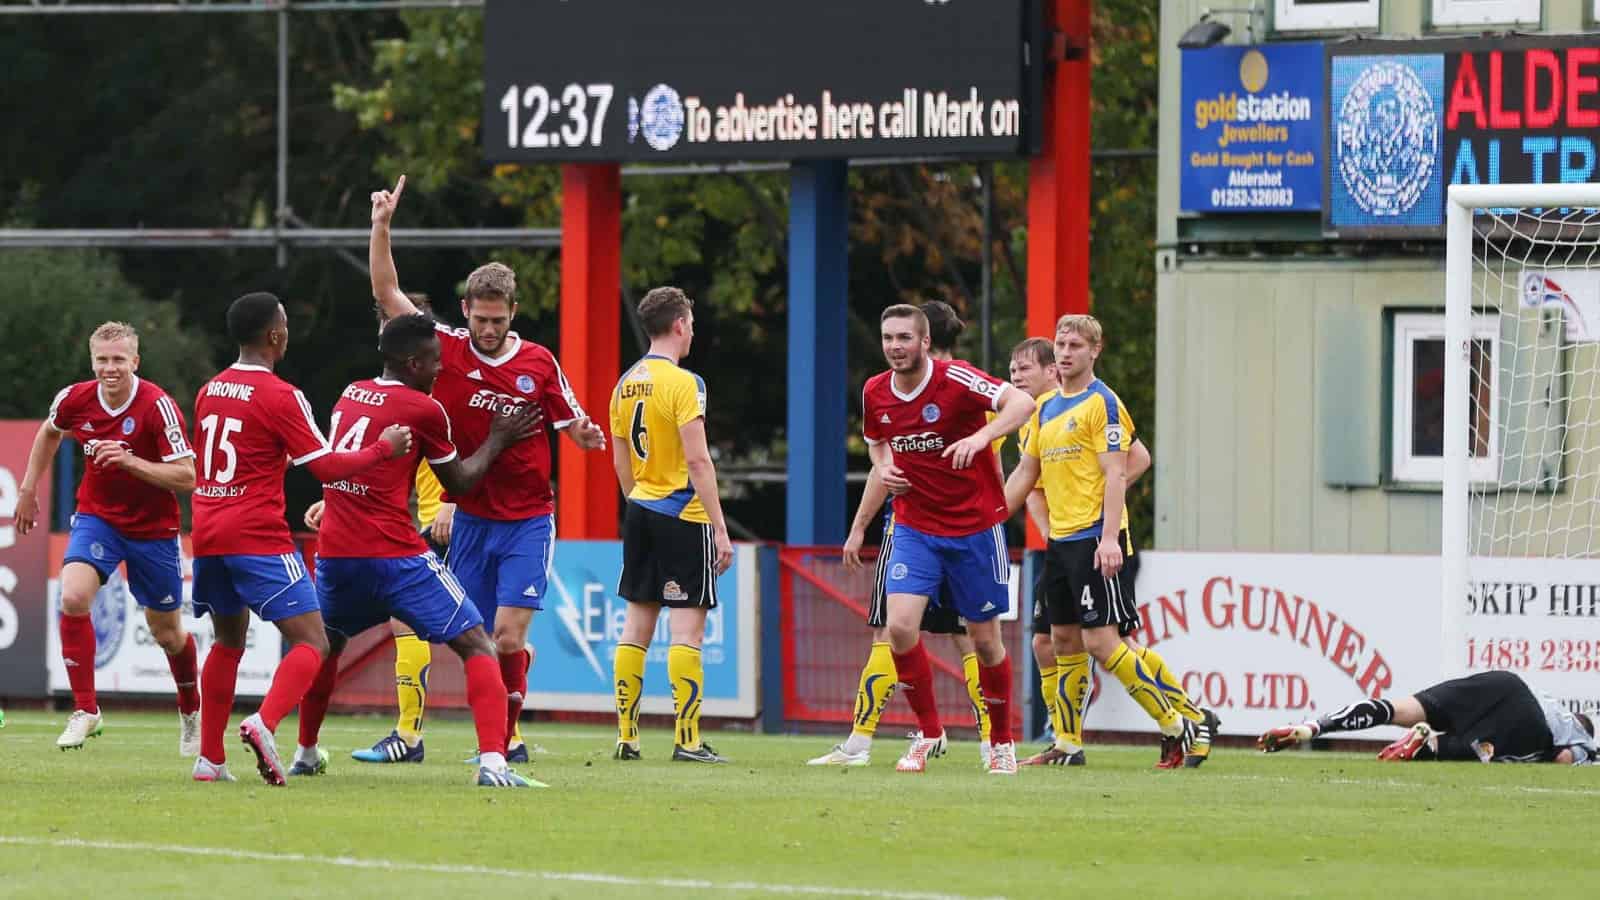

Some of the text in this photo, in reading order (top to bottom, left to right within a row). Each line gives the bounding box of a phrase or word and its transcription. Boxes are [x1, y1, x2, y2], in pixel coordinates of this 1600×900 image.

[1447, 47, 1600, 129] ALDE
[500, 84, 613, 148] 12:37
[684, 86, 1019, 143] To advertise here call Mark on
[1218, 122, 1288, 147] Jewellers
[1191, 150, 1314, 169] Gold Bought for Cash
[1228, 169, 1282, 187] Aldershot
[206, 381, 255, 402] BROWNE
[468, 391, 528, 417] Brige
[200, 413, 243, 484] 15
[328, 410, 372, 454] 14
[631, 400, 649, 460] 6
[890, 435, 945, 454] Bridges
[1079, 584, 1095, 611] 4
[1465, 582, 1539, 617] SKIP
[1202, 575, 1393, 701] GUNNER
[616, 679, 628, 716] ALTY
[1180, 670, 1317, 712] CO. LTD.
